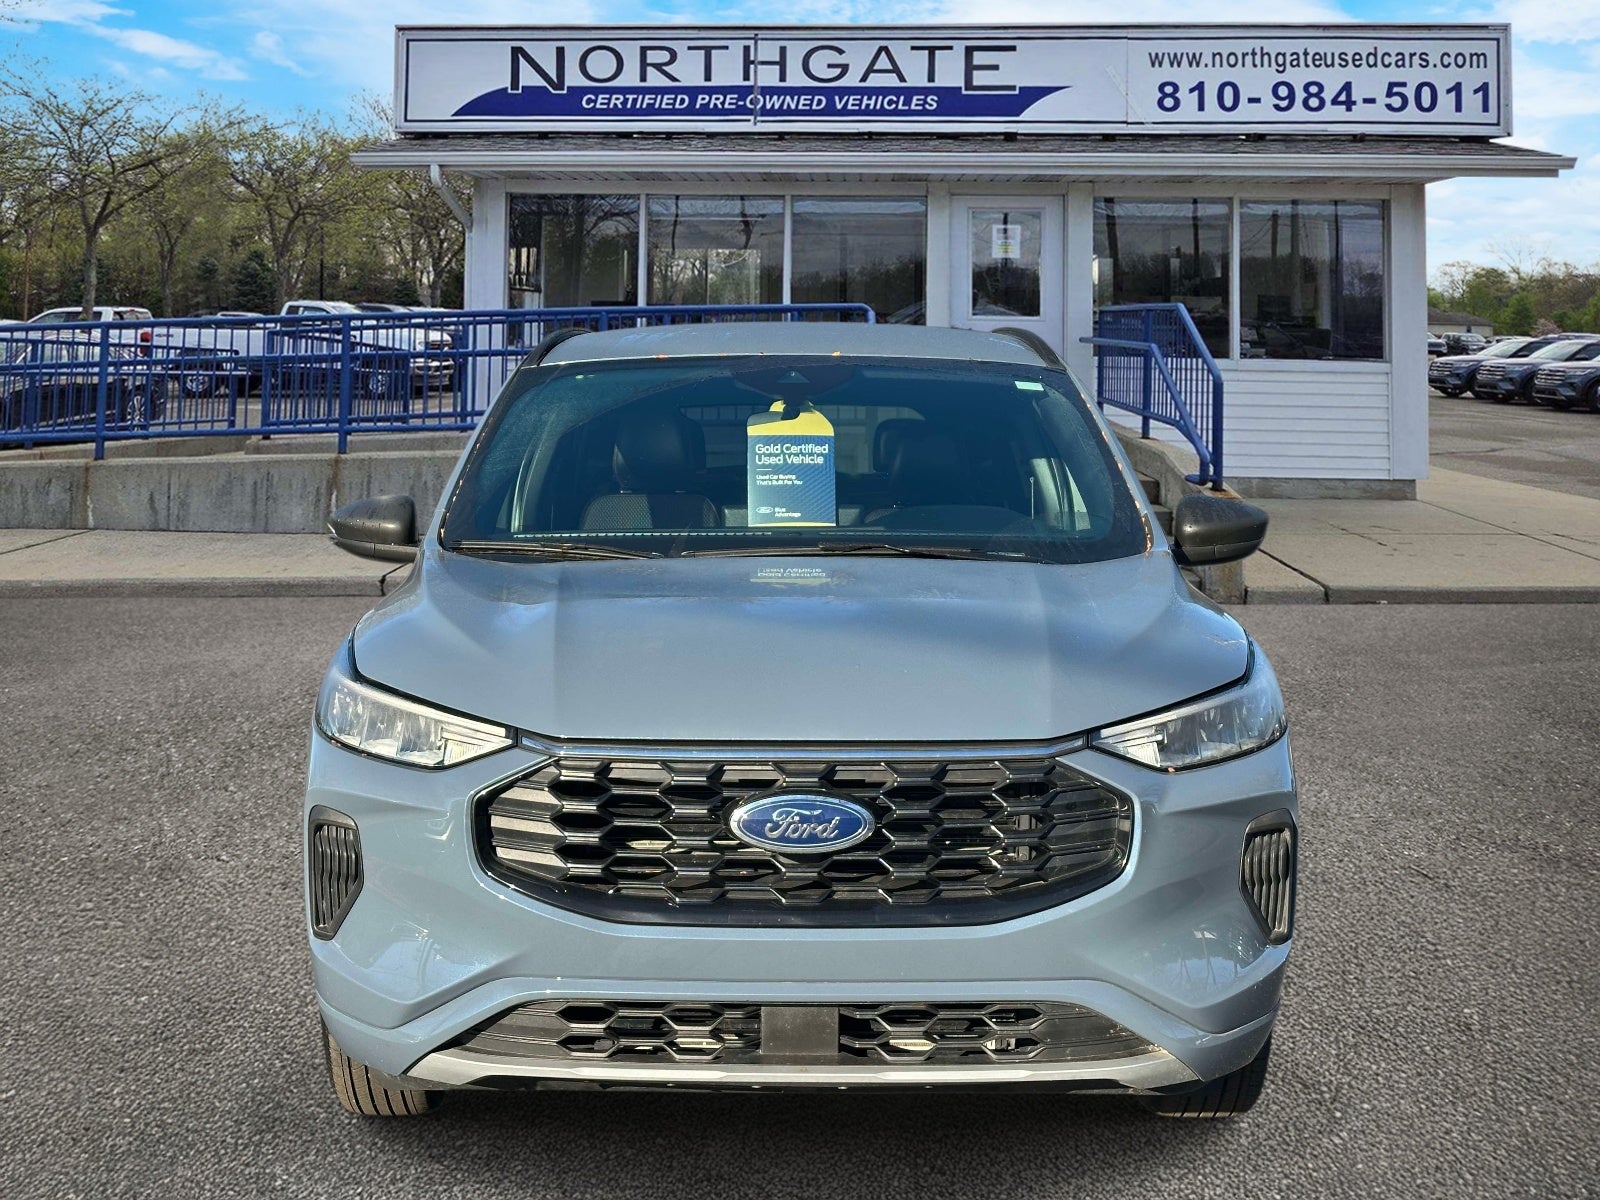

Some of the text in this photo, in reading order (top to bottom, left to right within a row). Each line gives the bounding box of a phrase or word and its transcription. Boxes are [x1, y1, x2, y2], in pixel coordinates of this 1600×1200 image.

[510, 44, 1018, 92] NORTHGATE
[1148, 46, 1489, 74] www.northgateusedcars.com
[581, 93, 939, 111] CERTIFIED PRE-OWNED VEHICLES
[1155, 80, 1492, 114] 810-984-5011
[755, 443, 829, 454] Gold Certified
[755, 453, 824, 464] Used Vehicle
[764, 807, 841, 839] Ford
